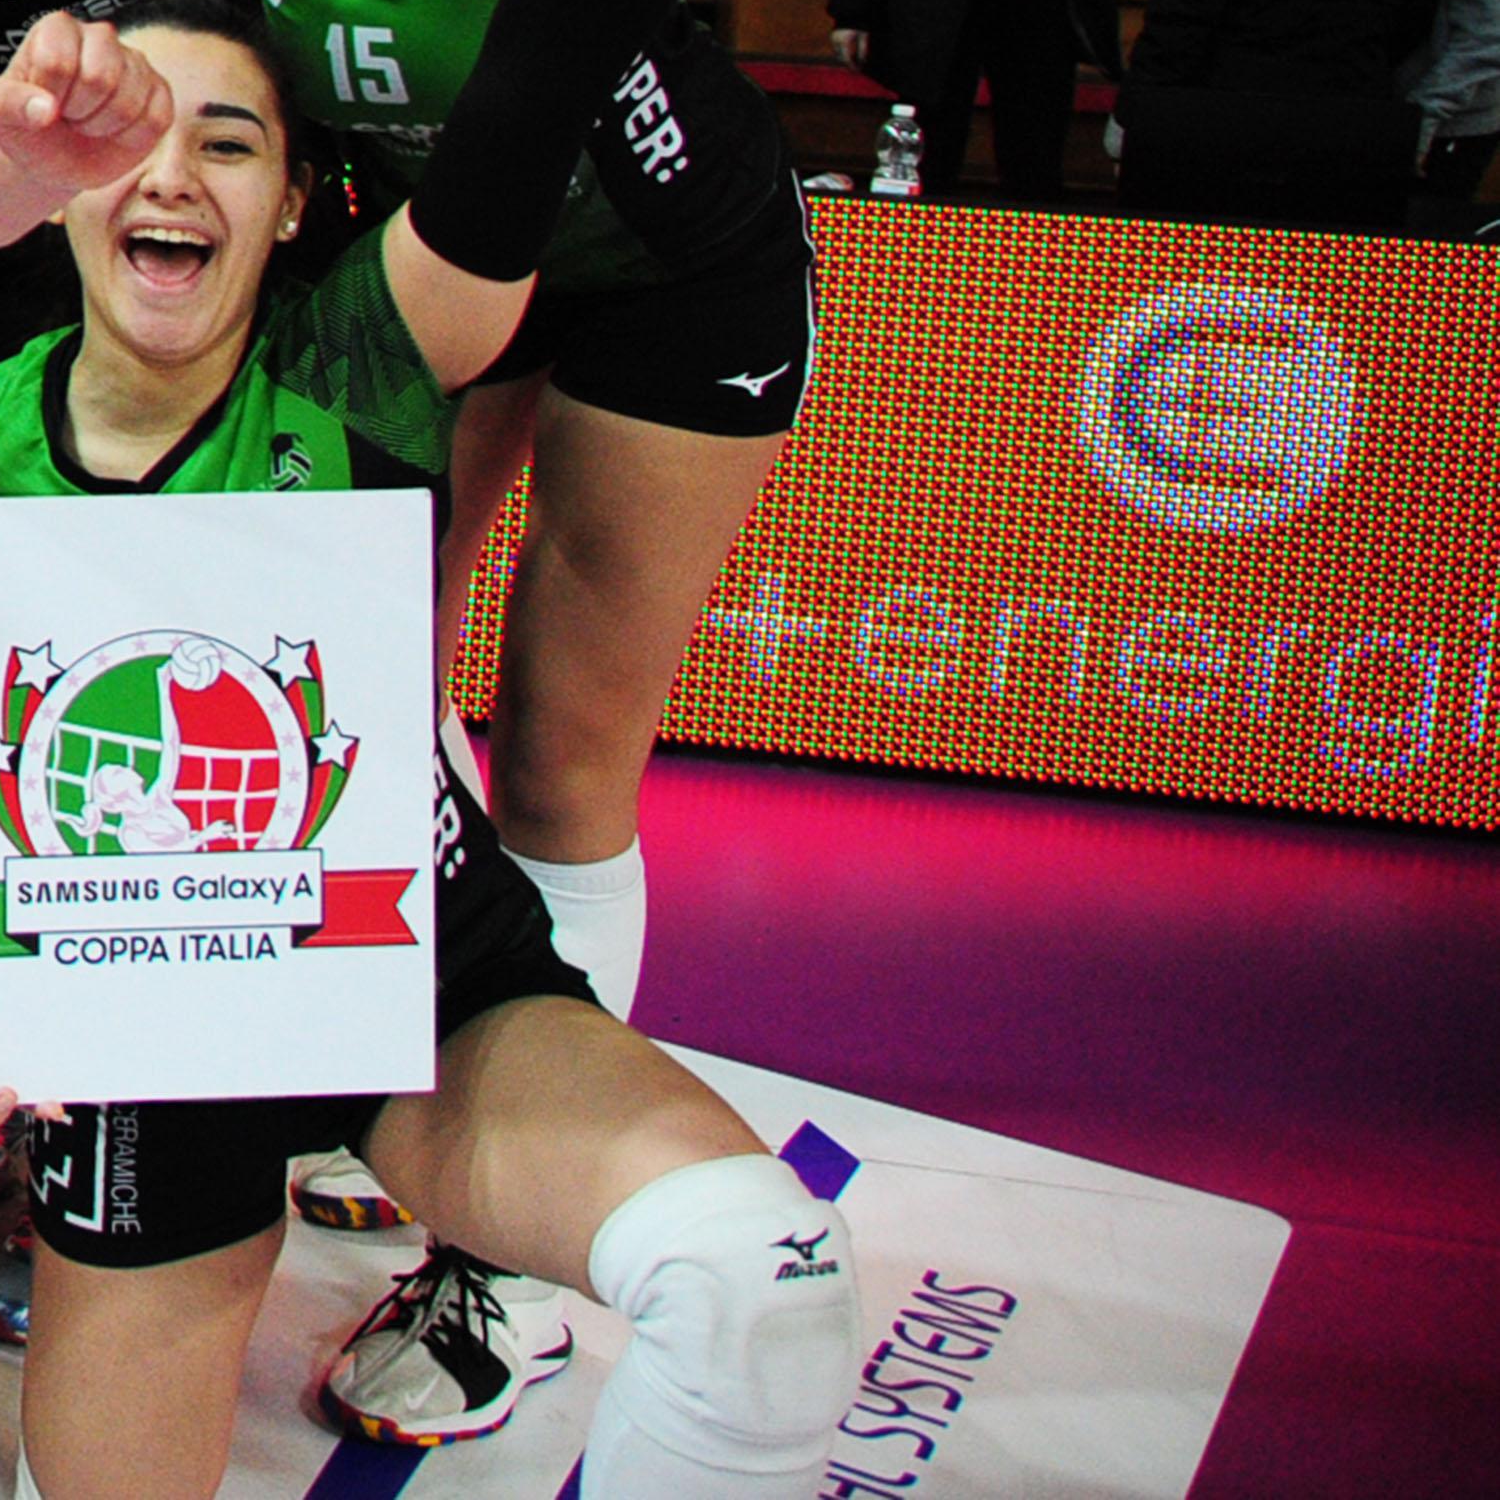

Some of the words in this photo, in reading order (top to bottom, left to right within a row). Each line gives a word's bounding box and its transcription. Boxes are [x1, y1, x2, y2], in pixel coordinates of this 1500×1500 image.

[325, 23, 410, 104] 15
[18, 877, 159, 904] SAMSUNG
[173, 873, 285, 906] Galaxy
[293, 873, 313, 897] A
[54, 933, 169, 965] COPPA
[181, 932, 277, 961] ITALIA
[836, 1269, 1017, 1461] SYSTEMS
